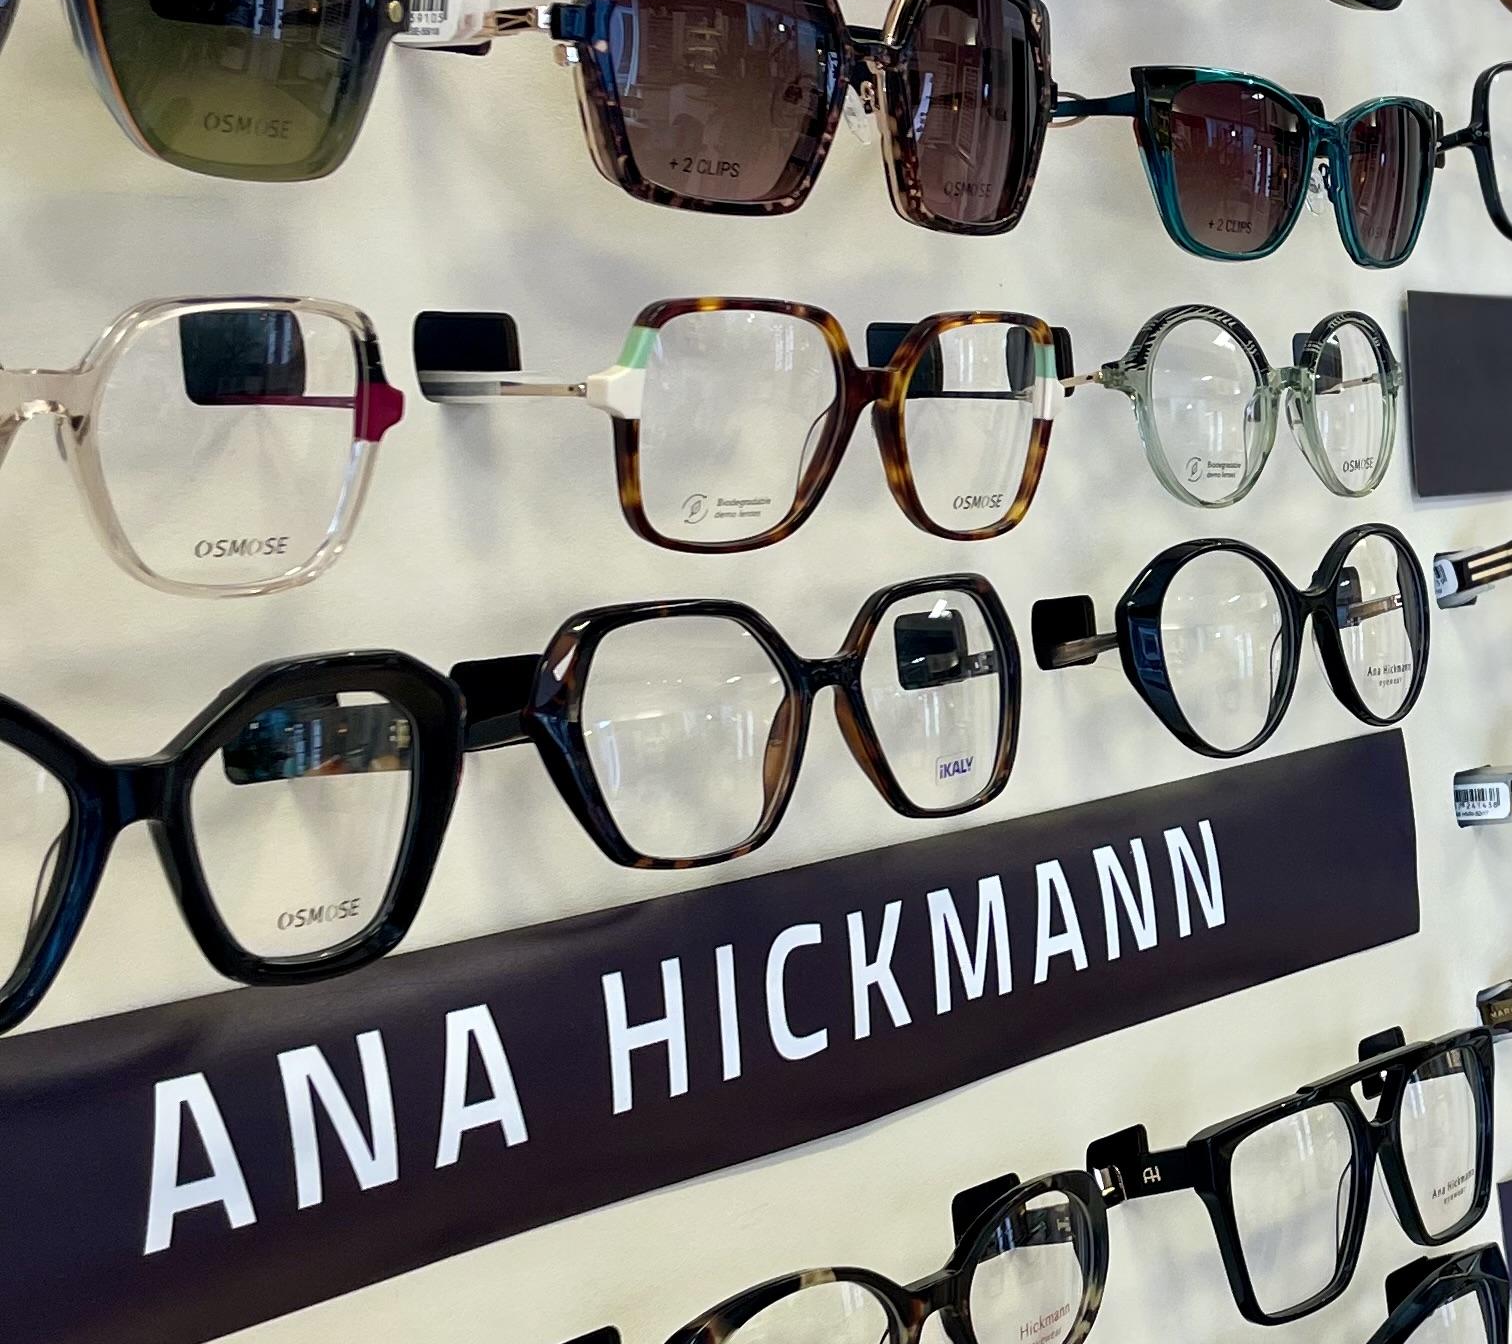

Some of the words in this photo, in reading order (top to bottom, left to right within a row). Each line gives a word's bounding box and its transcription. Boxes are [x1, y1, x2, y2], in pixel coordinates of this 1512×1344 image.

[203, 111, 293, 140] OSMOSE
[696, 158, 740, 178] CLIPS
[953, 493, 1004, 511] OSMOSE
[194, 536, 290, 559] OSMOSE
[277, 897, 361, 931] OSMOSE
[144, 1004, 529, 1255] ANA
[601, 819, 1227, 1115] HICKMANN
[1019, 1303, 1071, 1341] Hickmann
